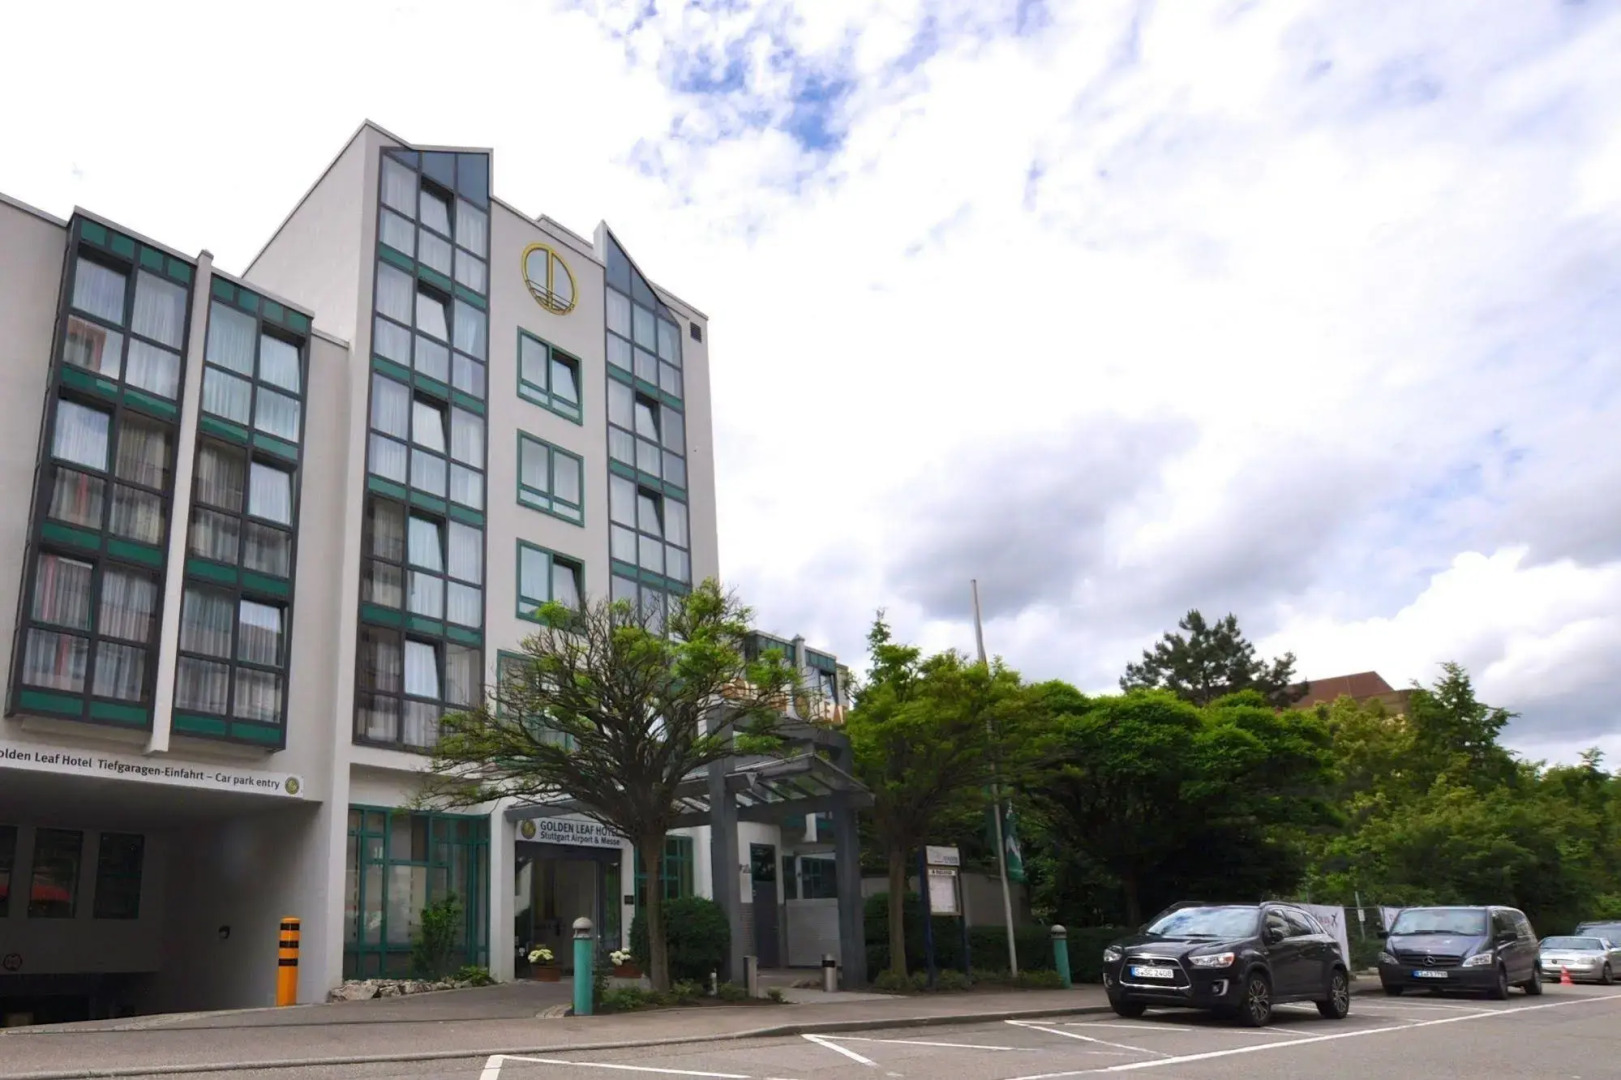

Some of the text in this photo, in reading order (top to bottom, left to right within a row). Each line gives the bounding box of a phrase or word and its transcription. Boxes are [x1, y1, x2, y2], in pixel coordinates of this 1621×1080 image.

[0, 748, 31, 761] olden
[35, 752, 60, 764] Leaf
[62, 755, 92, 768] Hotel
[98, 759, 204, 781] Tiefgaragen-Einfahrt
[215, 773, 231, 783] Car
[233, 777, 254, 786] park
[256, 779, 280, 790] entry
[540, 821, 574, 833] GOLDEN
[576, 825, 595, 834] LEAF
[540, 831, 570, 842] Stuttgart
[571, 835, 593, 844] Airport
[601, 837, 620, 846] Messe
